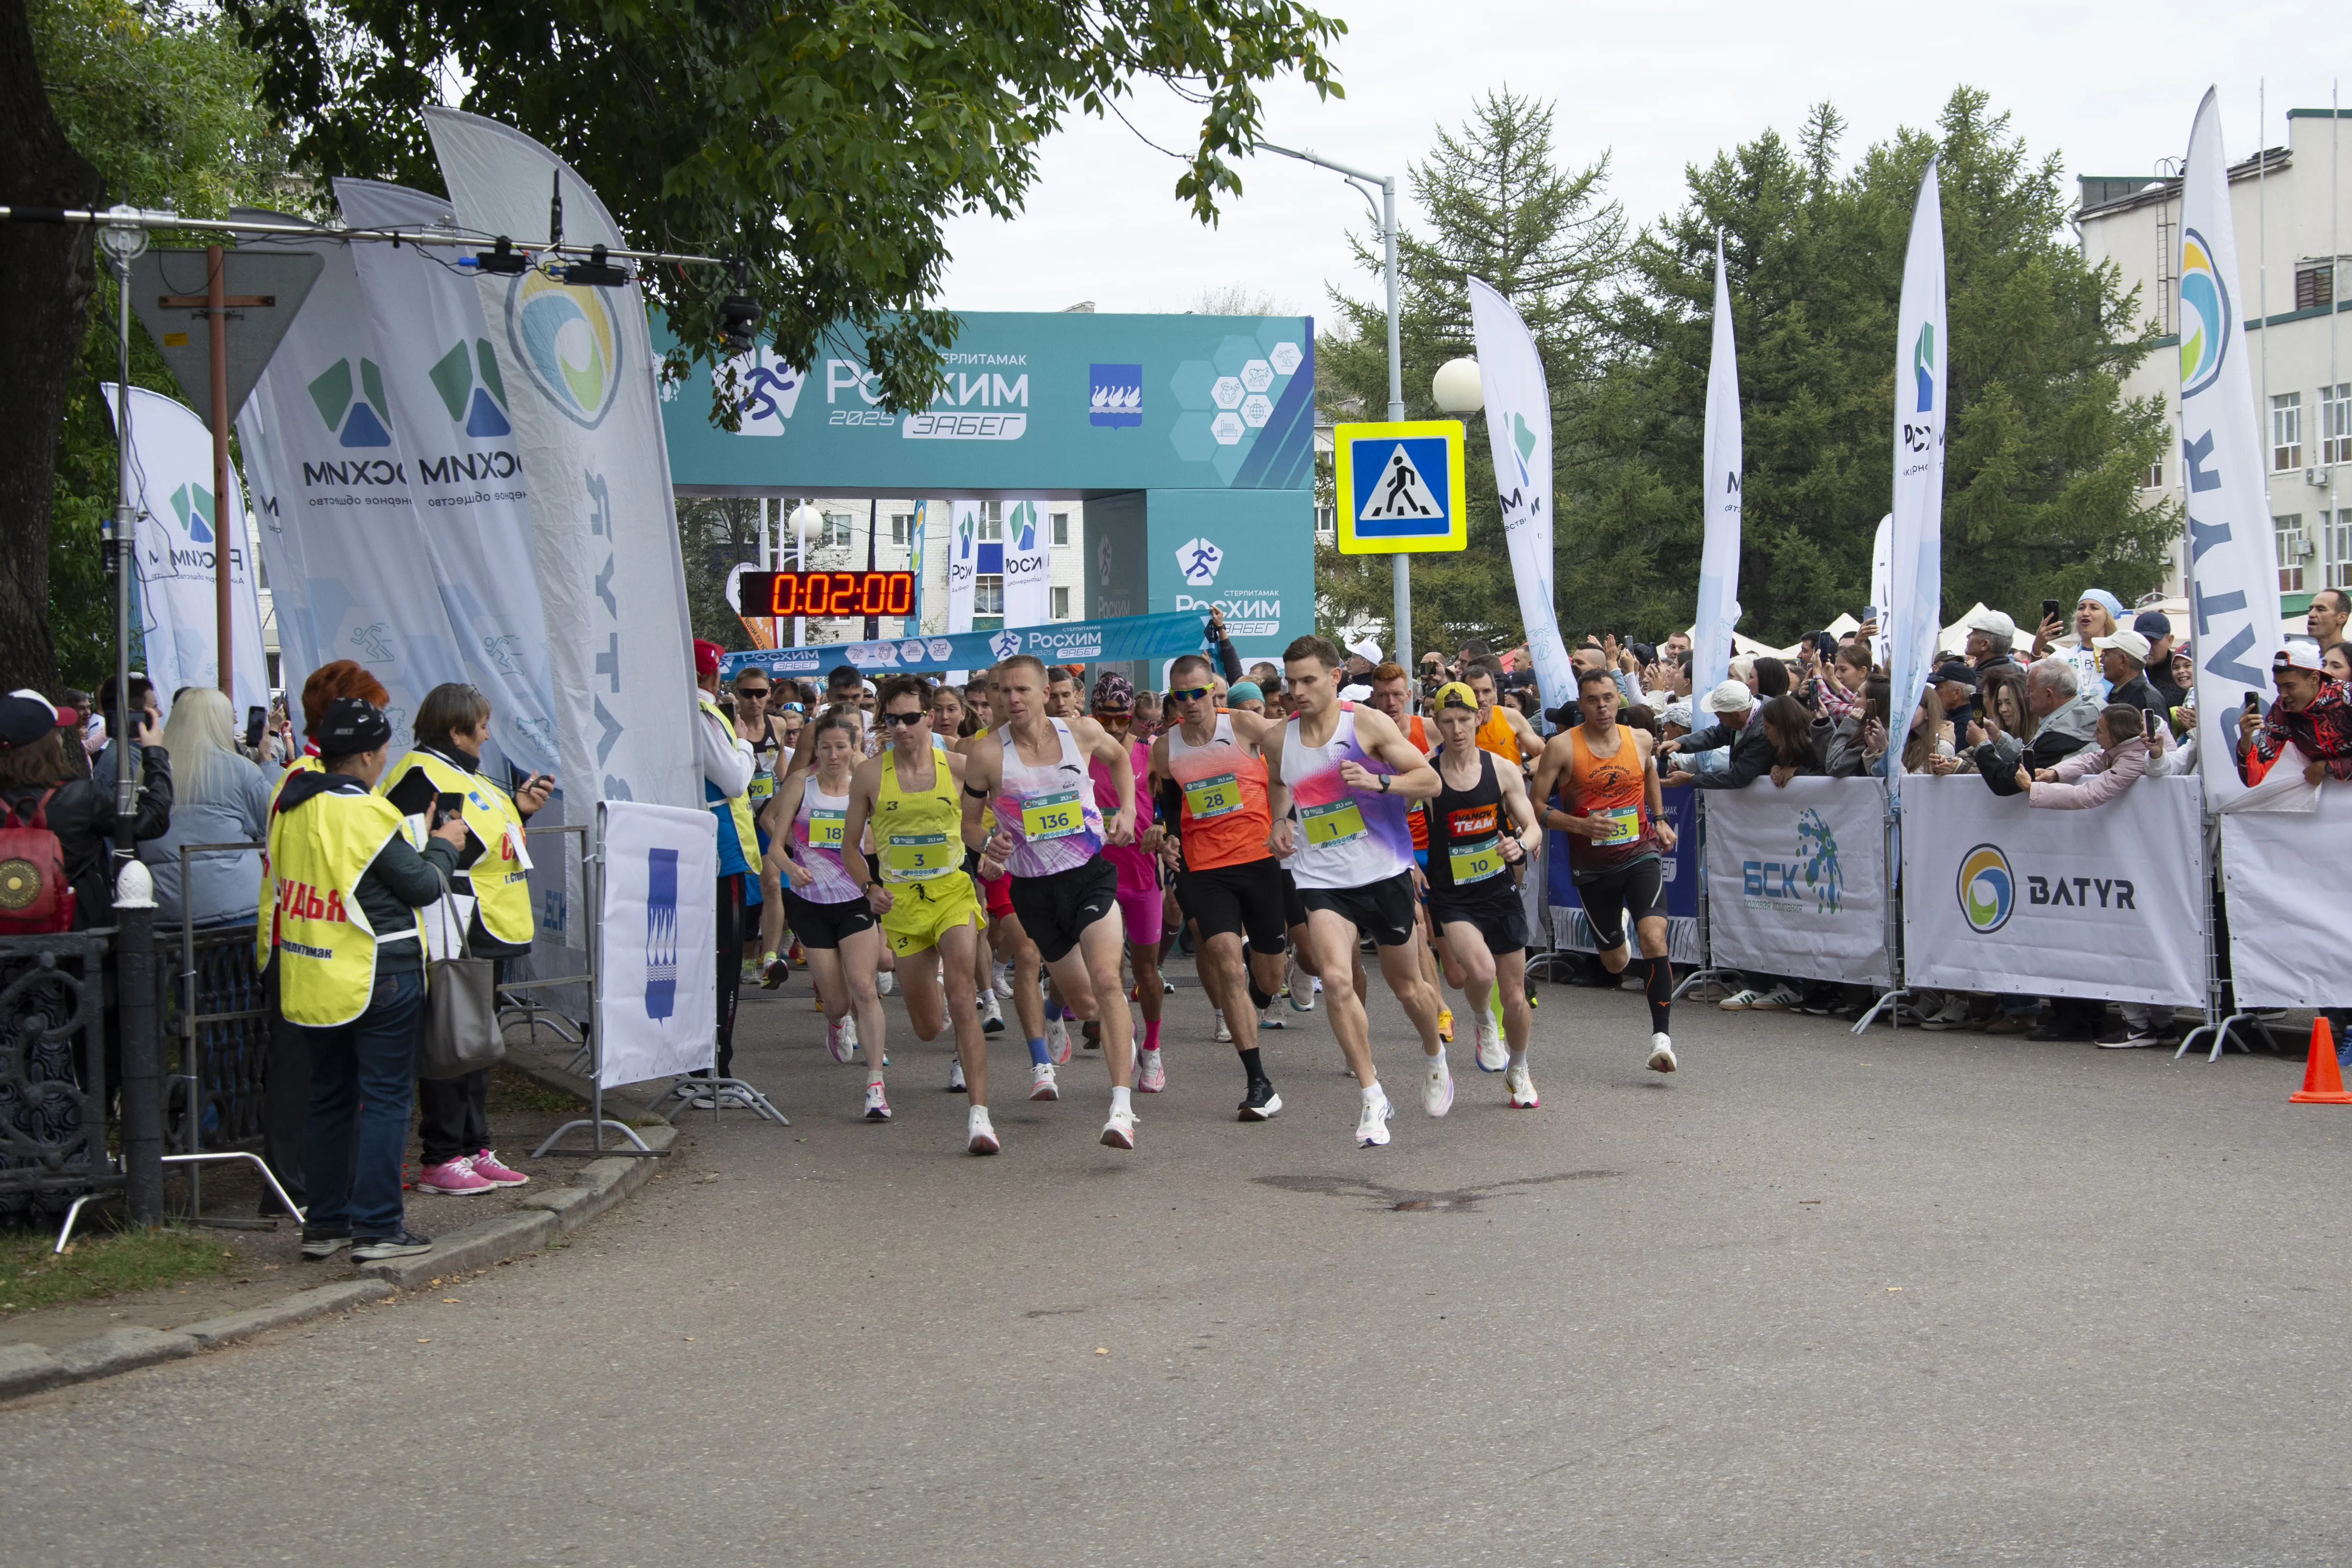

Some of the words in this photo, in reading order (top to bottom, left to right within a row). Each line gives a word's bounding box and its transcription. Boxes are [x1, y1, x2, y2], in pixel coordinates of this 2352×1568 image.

[938, 353, 1027, 366] ЕРЛИТАМАК
[829, 410, 895, 426] 2025
[913, 416, 1020, 436] ЗАБЕГ
[772, 574, 910, 614] 0:02:00
[1060, 647, 1099, 657] ЗАБЕГ
[777, 661, 817, 670] ЗАБЕГ
[1589, 765, 1613, 779] GOLDEN
[1614, 765, 1630, 775] RING
[1204, 794, 1224, 809] 28
[1039, 812, 1069, 830] 136
[1454, 810, 1492, 821] IVANOV
[1328, 822, 1338, 835] 1
[1454, 817, 1494, 832] TEAM
[825, 827, 845, 840] 18
[914, 853, 925, 867] 3
[1470, 859, 1488, 873] 10
[1743, 861, 1802, 900] БСК
[2027, 875, 2136, 910] BATYR
[1743, 899, 1771, 911] содовая
